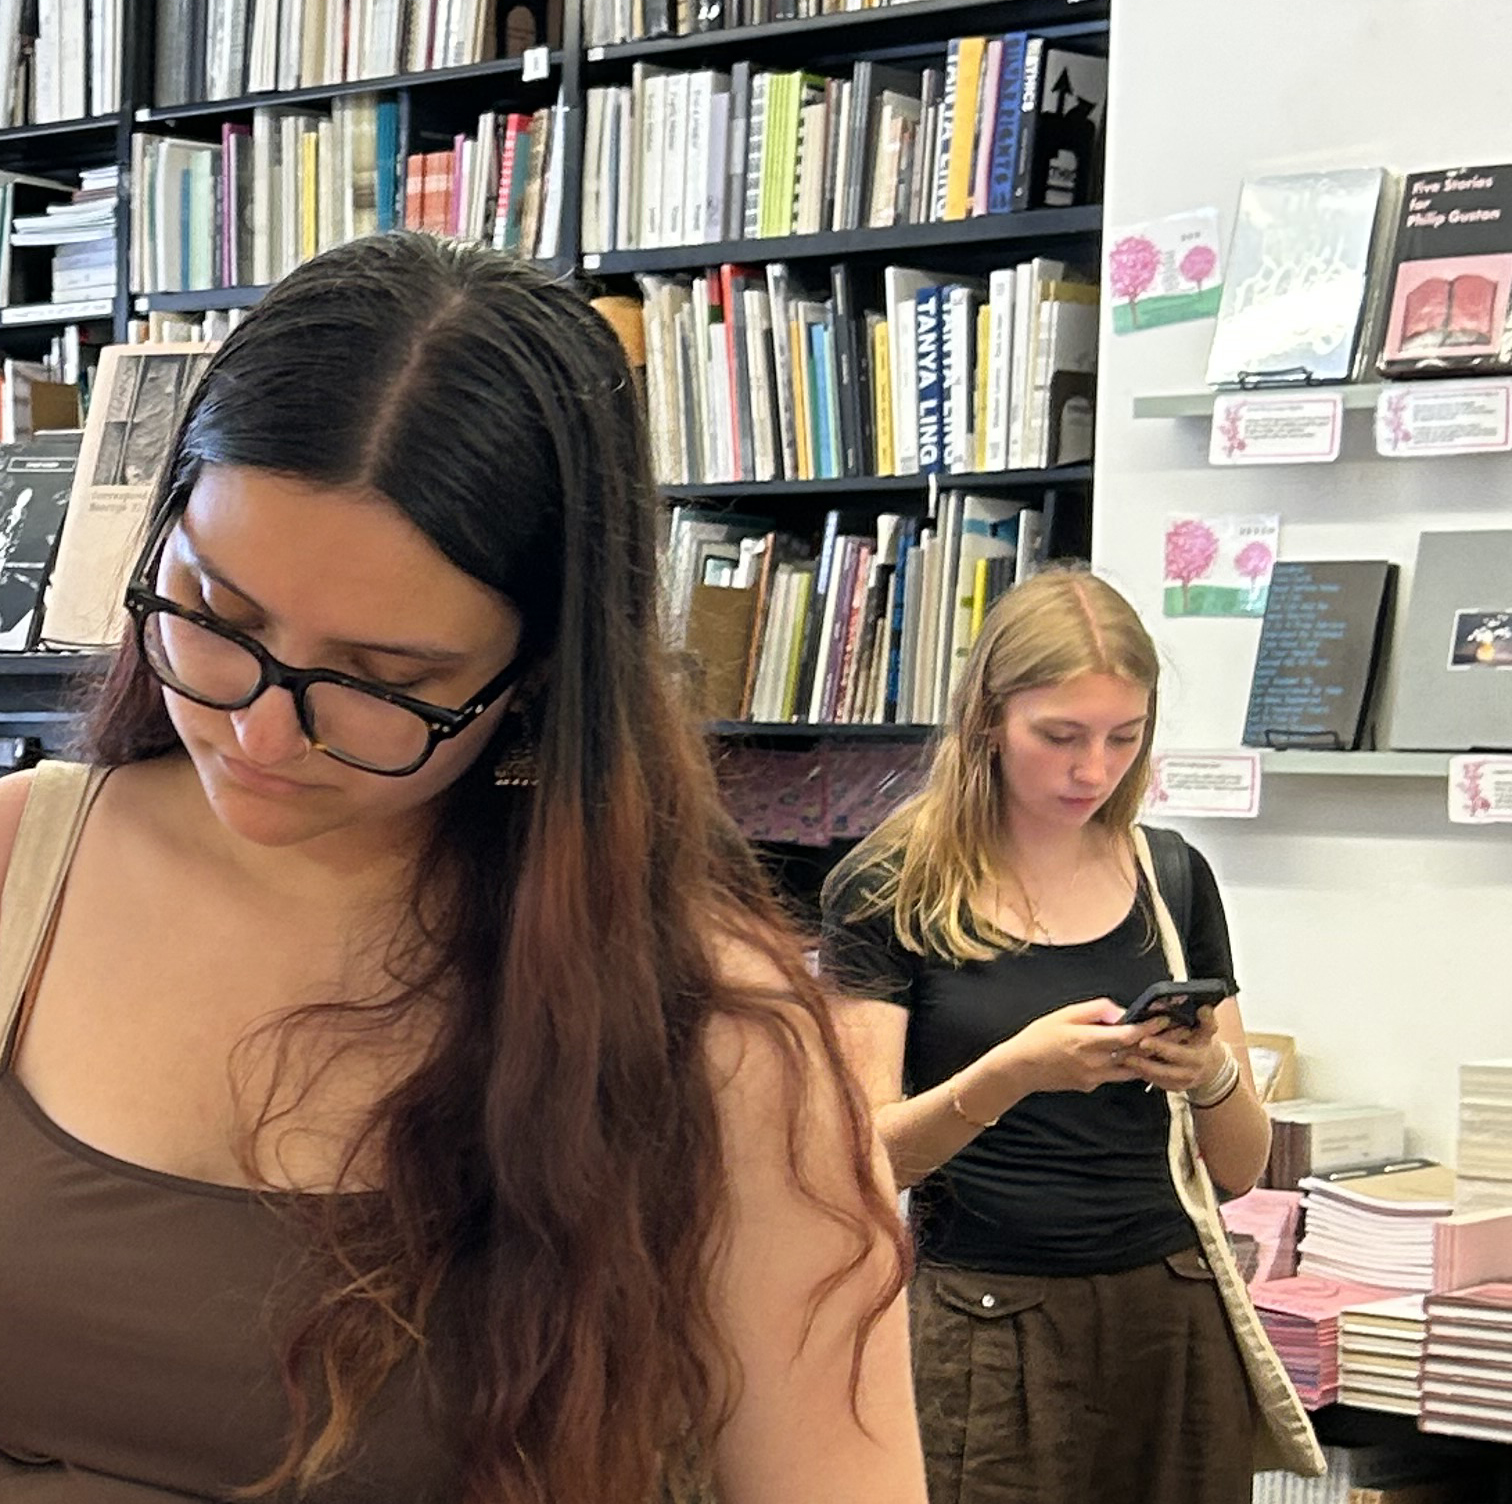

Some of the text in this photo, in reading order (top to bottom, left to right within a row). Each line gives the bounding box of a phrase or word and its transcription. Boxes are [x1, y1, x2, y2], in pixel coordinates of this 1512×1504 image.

[1443, 175, 1493, 192] Stories
[1409, 197, 1431, 211] for
[917, 296, 939, 466] TANYA LING
